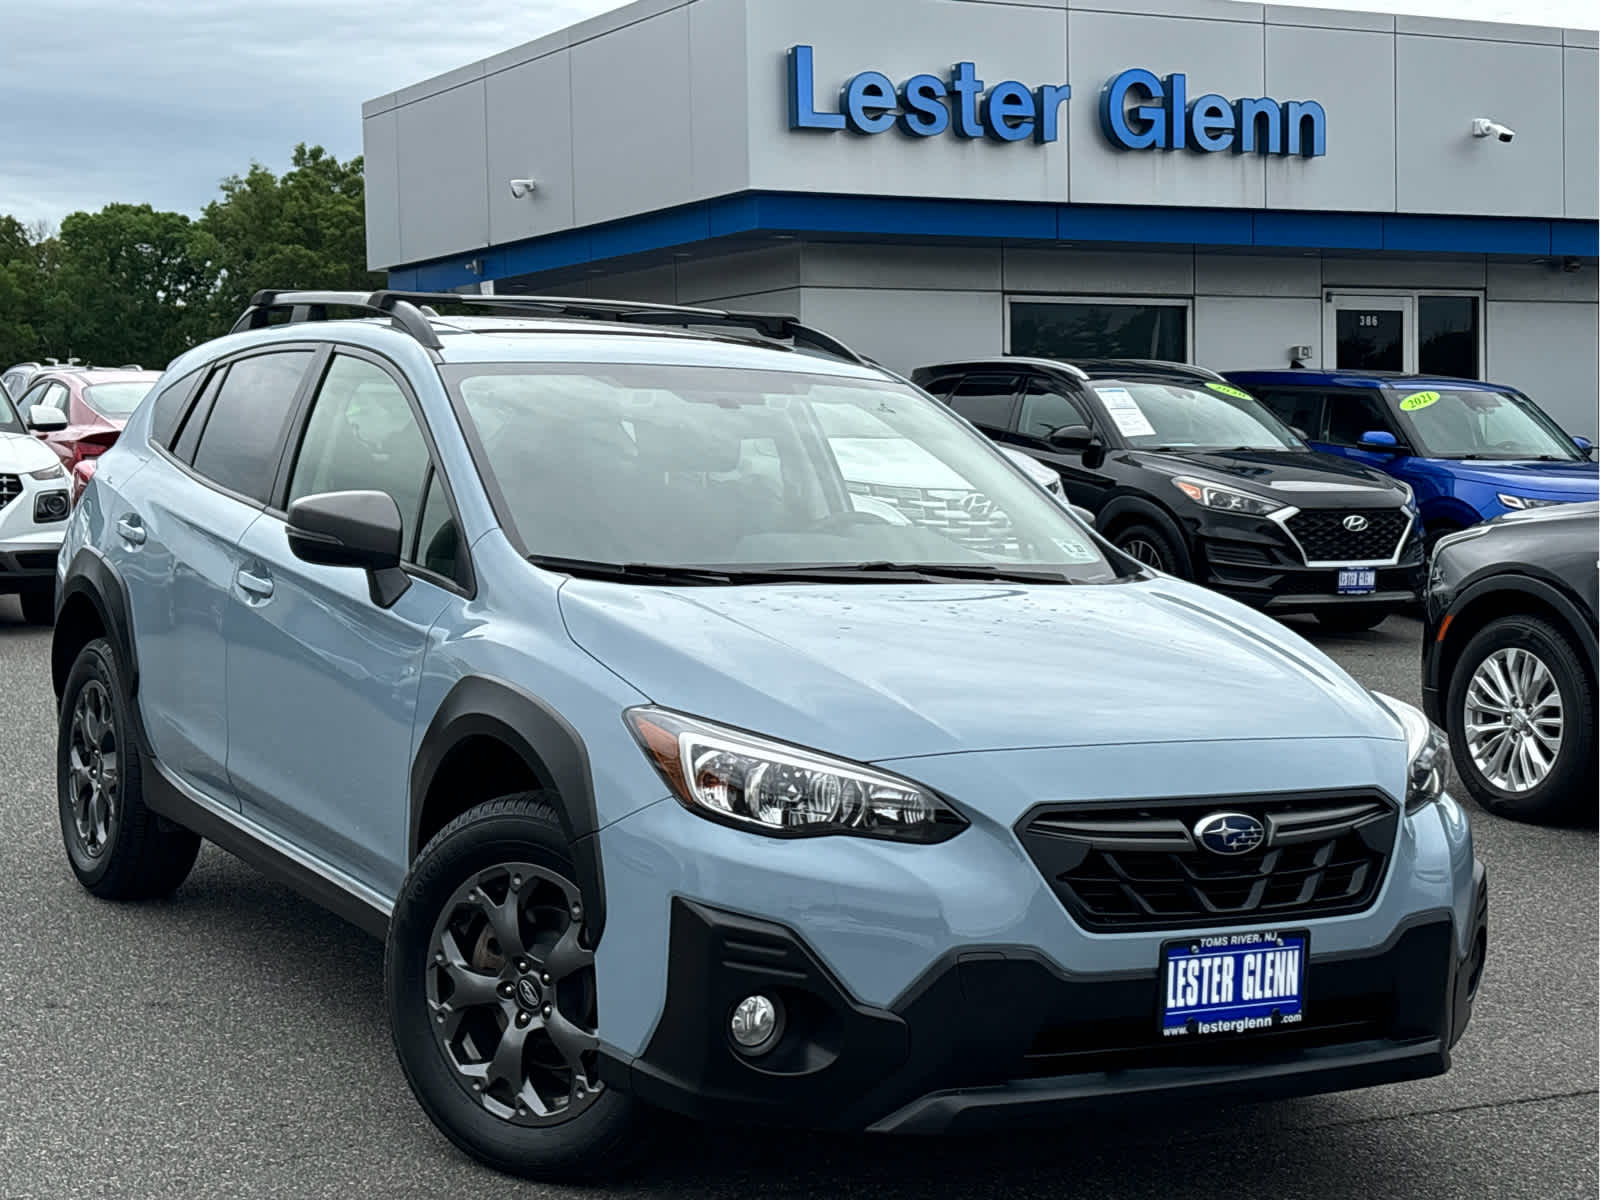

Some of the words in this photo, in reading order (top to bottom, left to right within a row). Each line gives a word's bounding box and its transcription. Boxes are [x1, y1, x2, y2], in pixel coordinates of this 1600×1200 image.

[788, 45, 1071, 143] Lester
[1100, 68, 1326, 157] Glenn
[1359, 315, 1378, 327] 386
[1407, 392, 1433, 408] 2021
[1201, 937, 1228, 948] TOMS
[1166, 956, 1235, 1009] LESTER
[1242, 950, 1300, 1001] GLENN
[1198, 1016, 1273, 1035] lesterglenn
